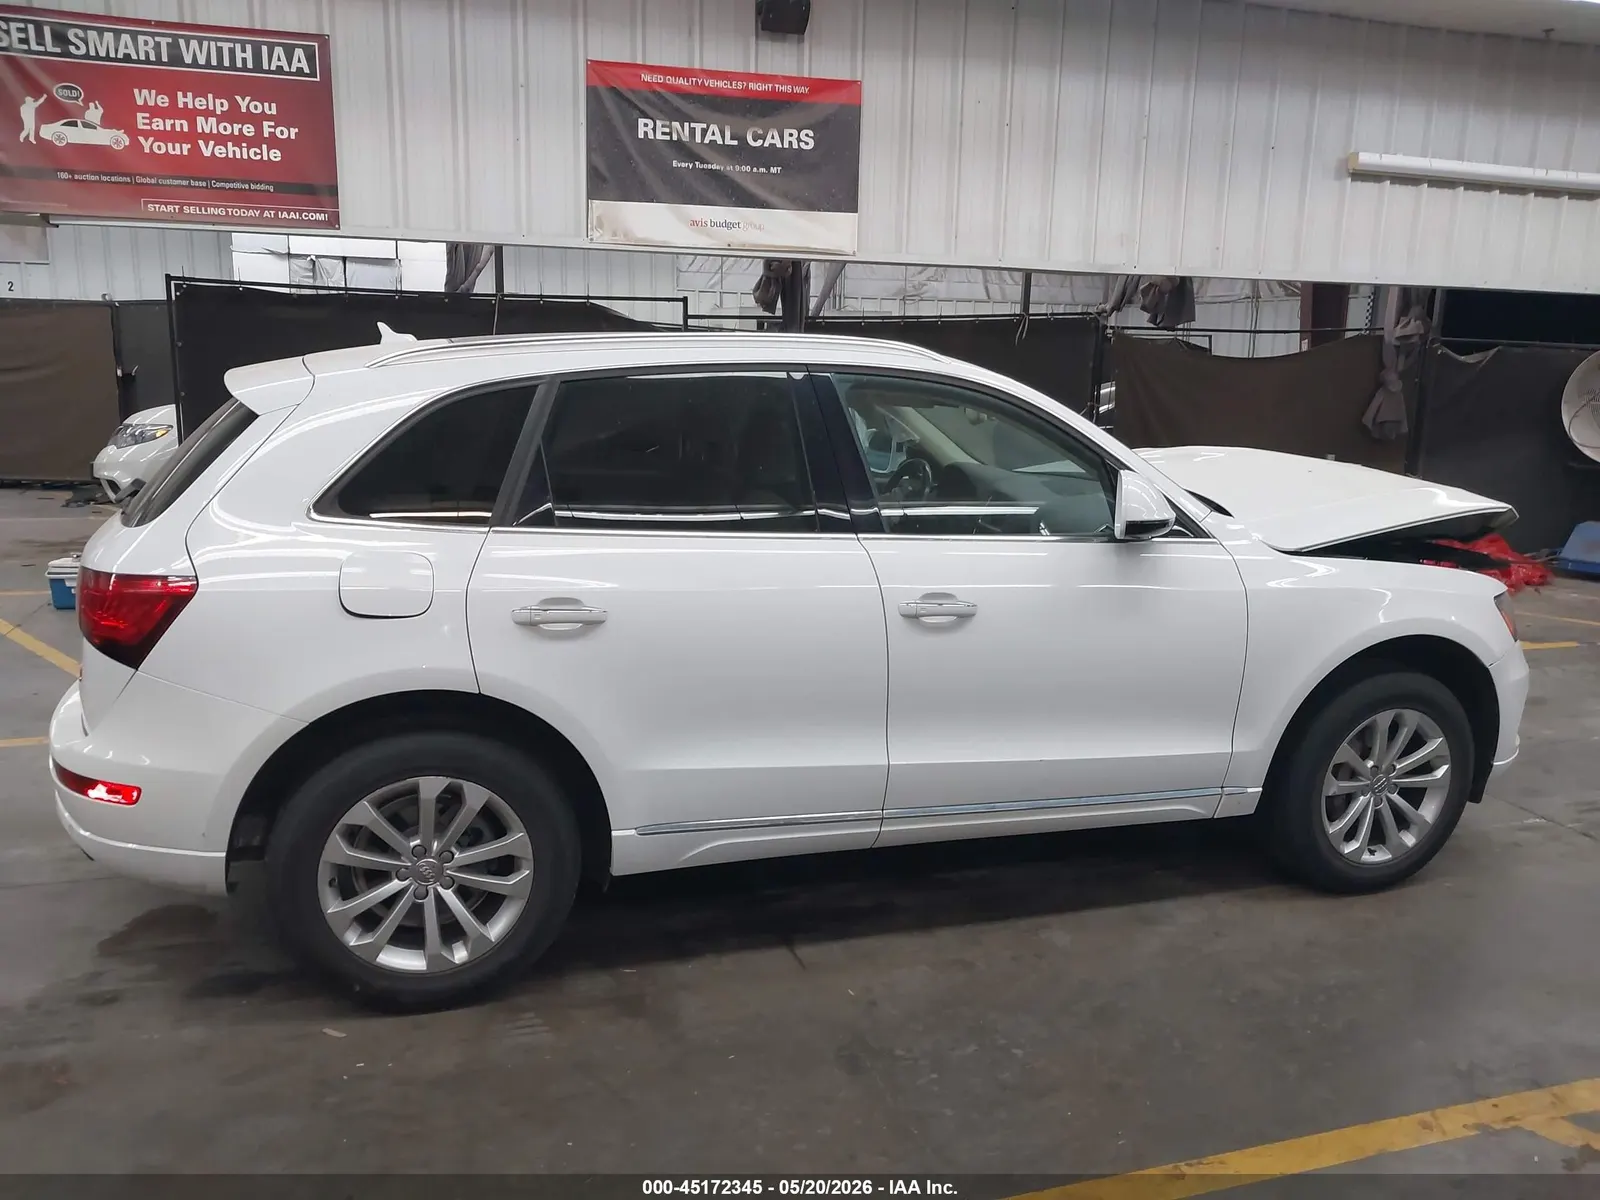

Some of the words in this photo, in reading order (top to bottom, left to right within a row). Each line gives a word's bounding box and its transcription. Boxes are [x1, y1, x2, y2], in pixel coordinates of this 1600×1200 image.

[67, 28, 172, 62] SMART
[178, 38, 253, 68] WITH
[261, 45, 310, 74] IAA
[57, 88, 80, 98] SOLD!
[641, 73, 663, 83] NEED
[666, 76, 703, 87] QUALITY
[703, 78, 746, 90] VEHICLES?
[749, 82, 773, 92] RIGHT
[775, 84, 792, 93] THIS
[133, 88, 169, 107] We
[177, 91, 229, 114] Help
[235, 95, 277, 115] You
[136, 112, 188, 132] Earn
[196, 116, 255, 136] More
[262, 121, 299, 139] For
[637, 117, 738, 146] RENTAL
[746, 126, 815, 150] CARS
[138, 135, 191, 155] Your
[197, 139, 282, 162] Vehicle
[672, 160, 693, 170] Every
[694, 161, 724, 172] Tuesday
[770, 166, 782, 174] MT
[74, 173, 99, 181] auction
[101, 174, 131, 183] locations
[135, 176, 157, 184] Global
[158, 178, 189, 186] customer
[190, 179, 206, 187] base
[211, 180, 249, 190] Competitive
[250, 183, 274, 193] bidding
[147, 203, 180, 213] START
[183, 205, 226, 216] SELLING
[227, 208, 260, 217] TODAY
[263, 210, 275, 218] AT
[278, 210, 328, 221] IAAI.COM!
[690, 218, 708, 228] avis
[709, 219, 741, 230] budget
[7, 280, 14, 292] 2
